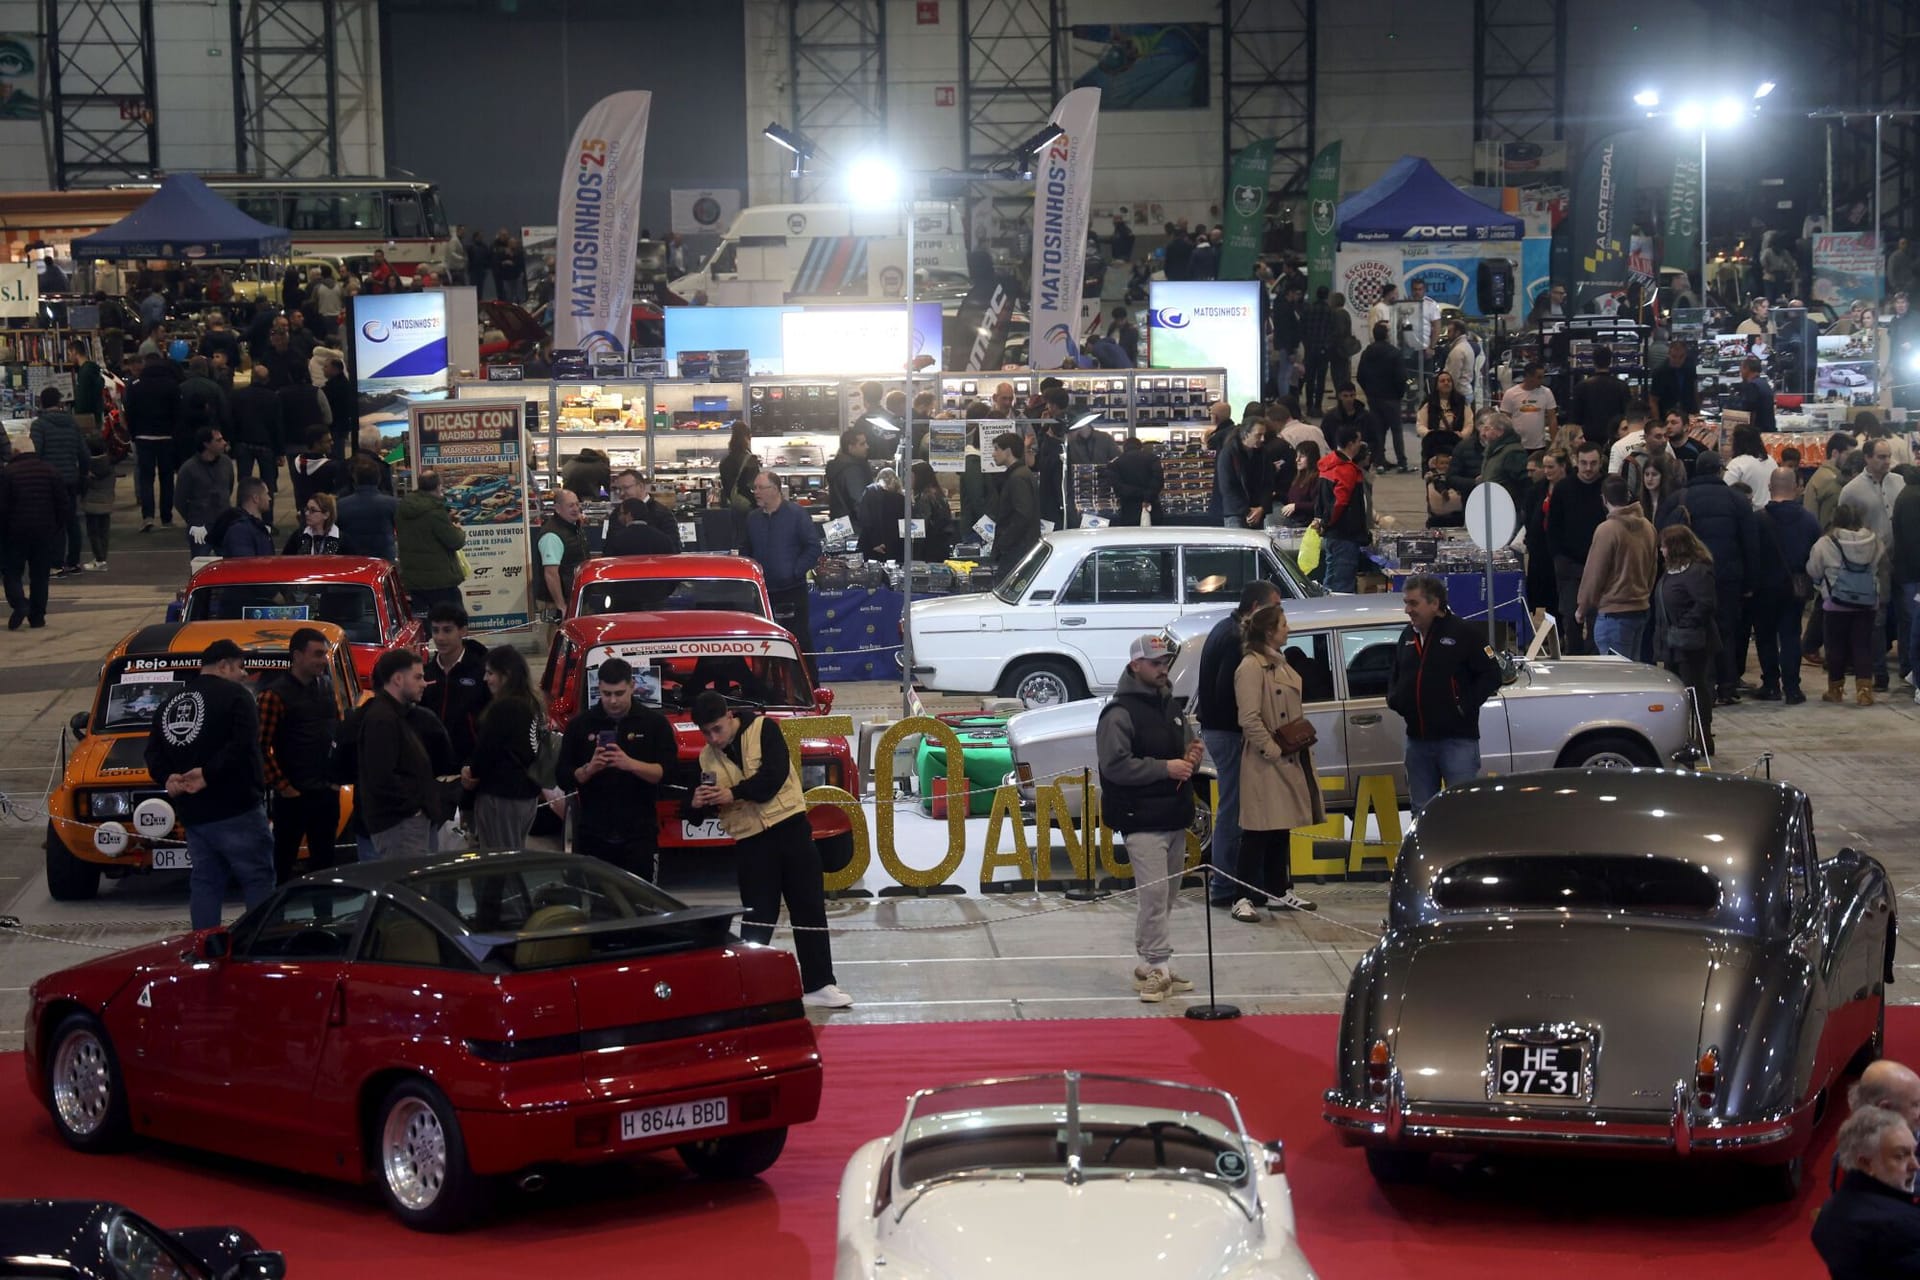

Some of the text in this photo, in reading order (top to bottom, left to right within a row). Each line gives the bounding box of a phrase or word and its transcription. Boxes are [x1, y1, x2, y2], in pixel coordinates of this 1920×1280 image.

[1597, 144, 1614, 233] CATEDRAL
[1345, 262, 1392, 280] ESCUDERIA
[1356, 269, 1381, 279] VIGO
[423, 411, 513, 431] DIECAST CON
[438, 429, 501, 441] MADRID 2025
[443, 446, 470, 454] MARCH
[437, 456, 462, 464] BIGGEST
[498, 454, 517, 462] EVENT
[469, 527, 524, 537] CUATRO VIENTOS
[491, 537, 512, 545] ESPAÑA
[474, 566, 494, 576] GT
[621, 643, 754, 654] ELECTRICIDAD CONDADO
[124, 661, 132, 671] J
[136, 658, 168, 670] Rejo
[1523, 1047, 1559, 1072] HE
[1502, 1070, 1579, 1095] 97-31
[624, 1100, 726, 1137] H 8644 BBD
